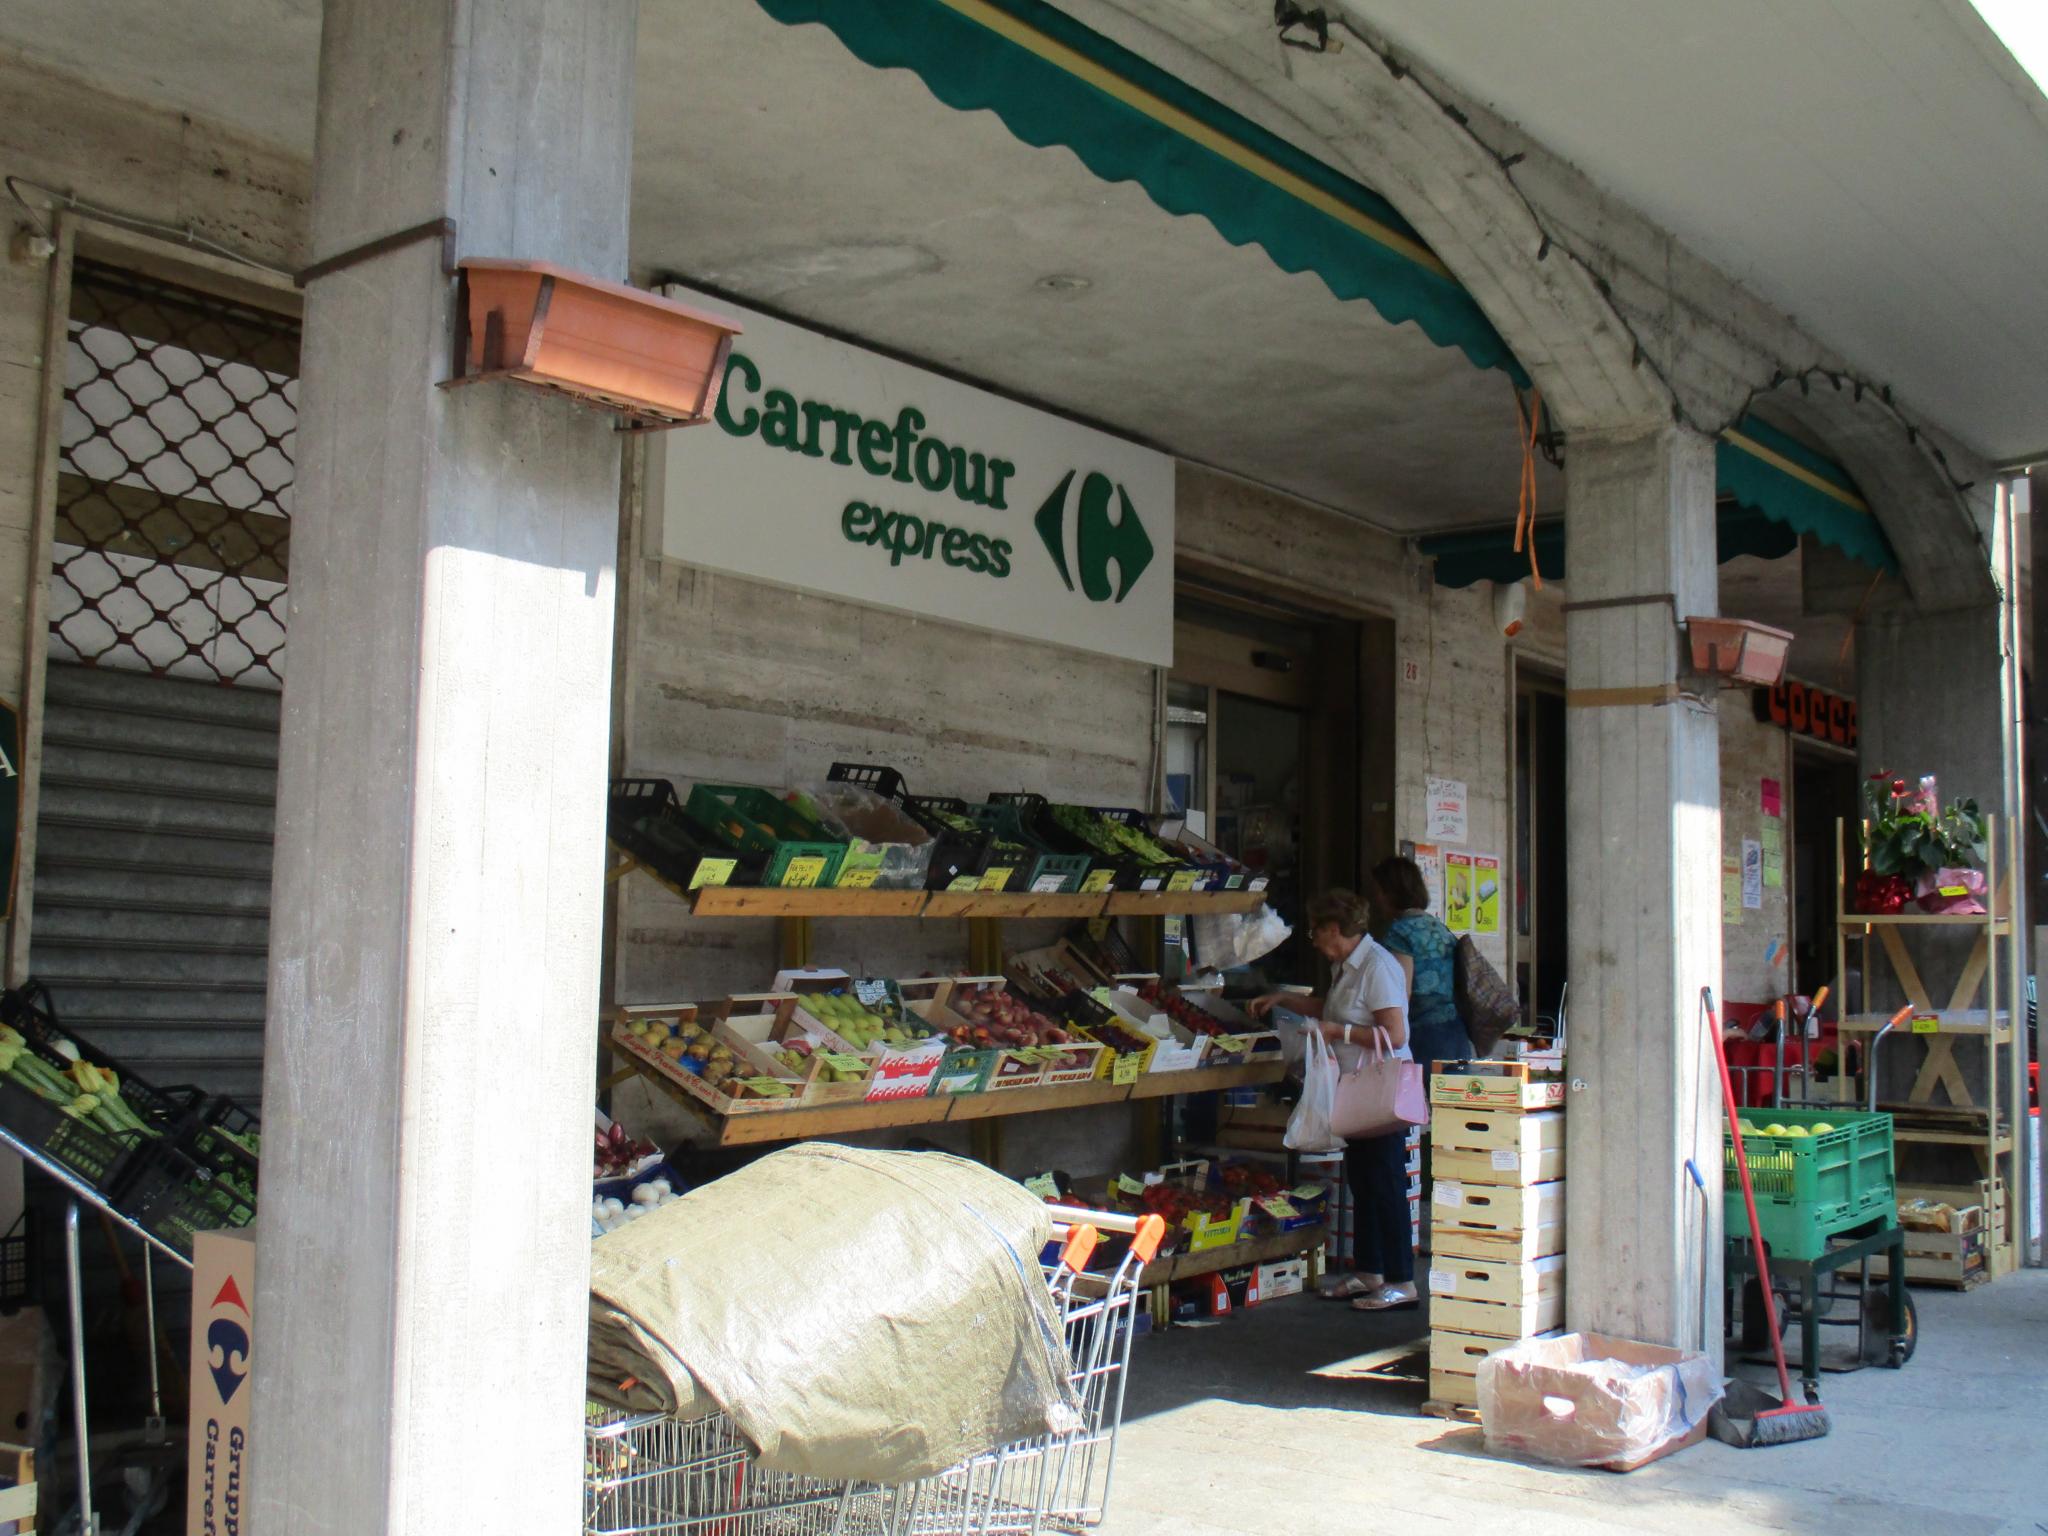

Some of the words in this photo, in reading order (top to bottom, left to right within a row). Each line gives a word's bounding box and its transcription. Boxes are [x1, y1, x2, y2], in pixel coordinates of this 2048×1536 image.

[714, 353, 1016, 510] Carrefour
[841, 500, 1012, 579] express
[204, 1418, 219, 1536] Carref
